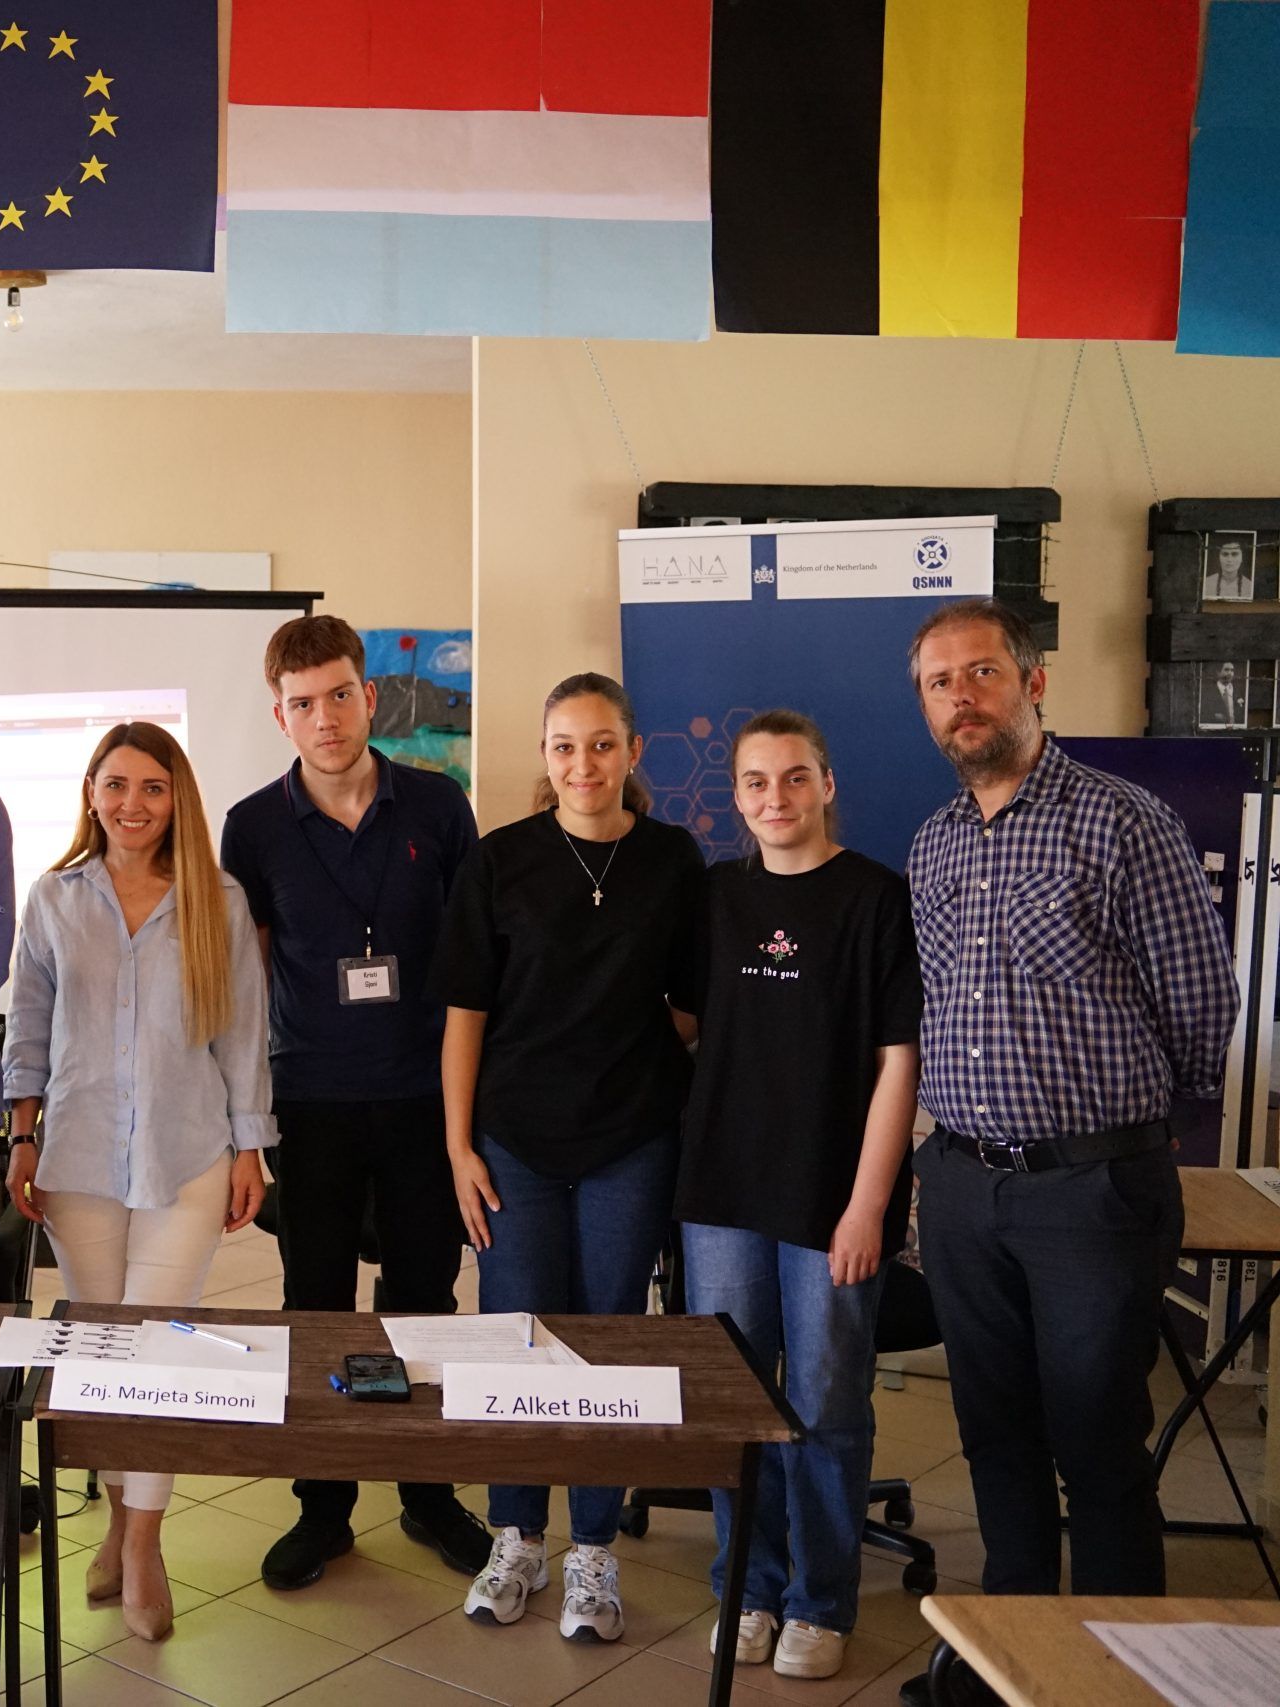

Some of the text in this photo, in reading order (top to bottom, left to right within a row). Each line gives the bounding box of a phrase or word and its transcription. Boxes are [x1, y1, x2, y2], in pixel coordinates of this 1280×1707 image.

[783, 565, 813, 573] Kingdom
[836, 563, 878, 571] Netherlands
[912, 576, 952, 590] QSNNN
[742, 966, 799, 980] see the good
[1216, 1260, 1227, 1282] 816
[80, 1383, 256, 1409] Znj. Marjeta Simoni
[485, 1395, 639, 1418] Z. Alket Bushi
